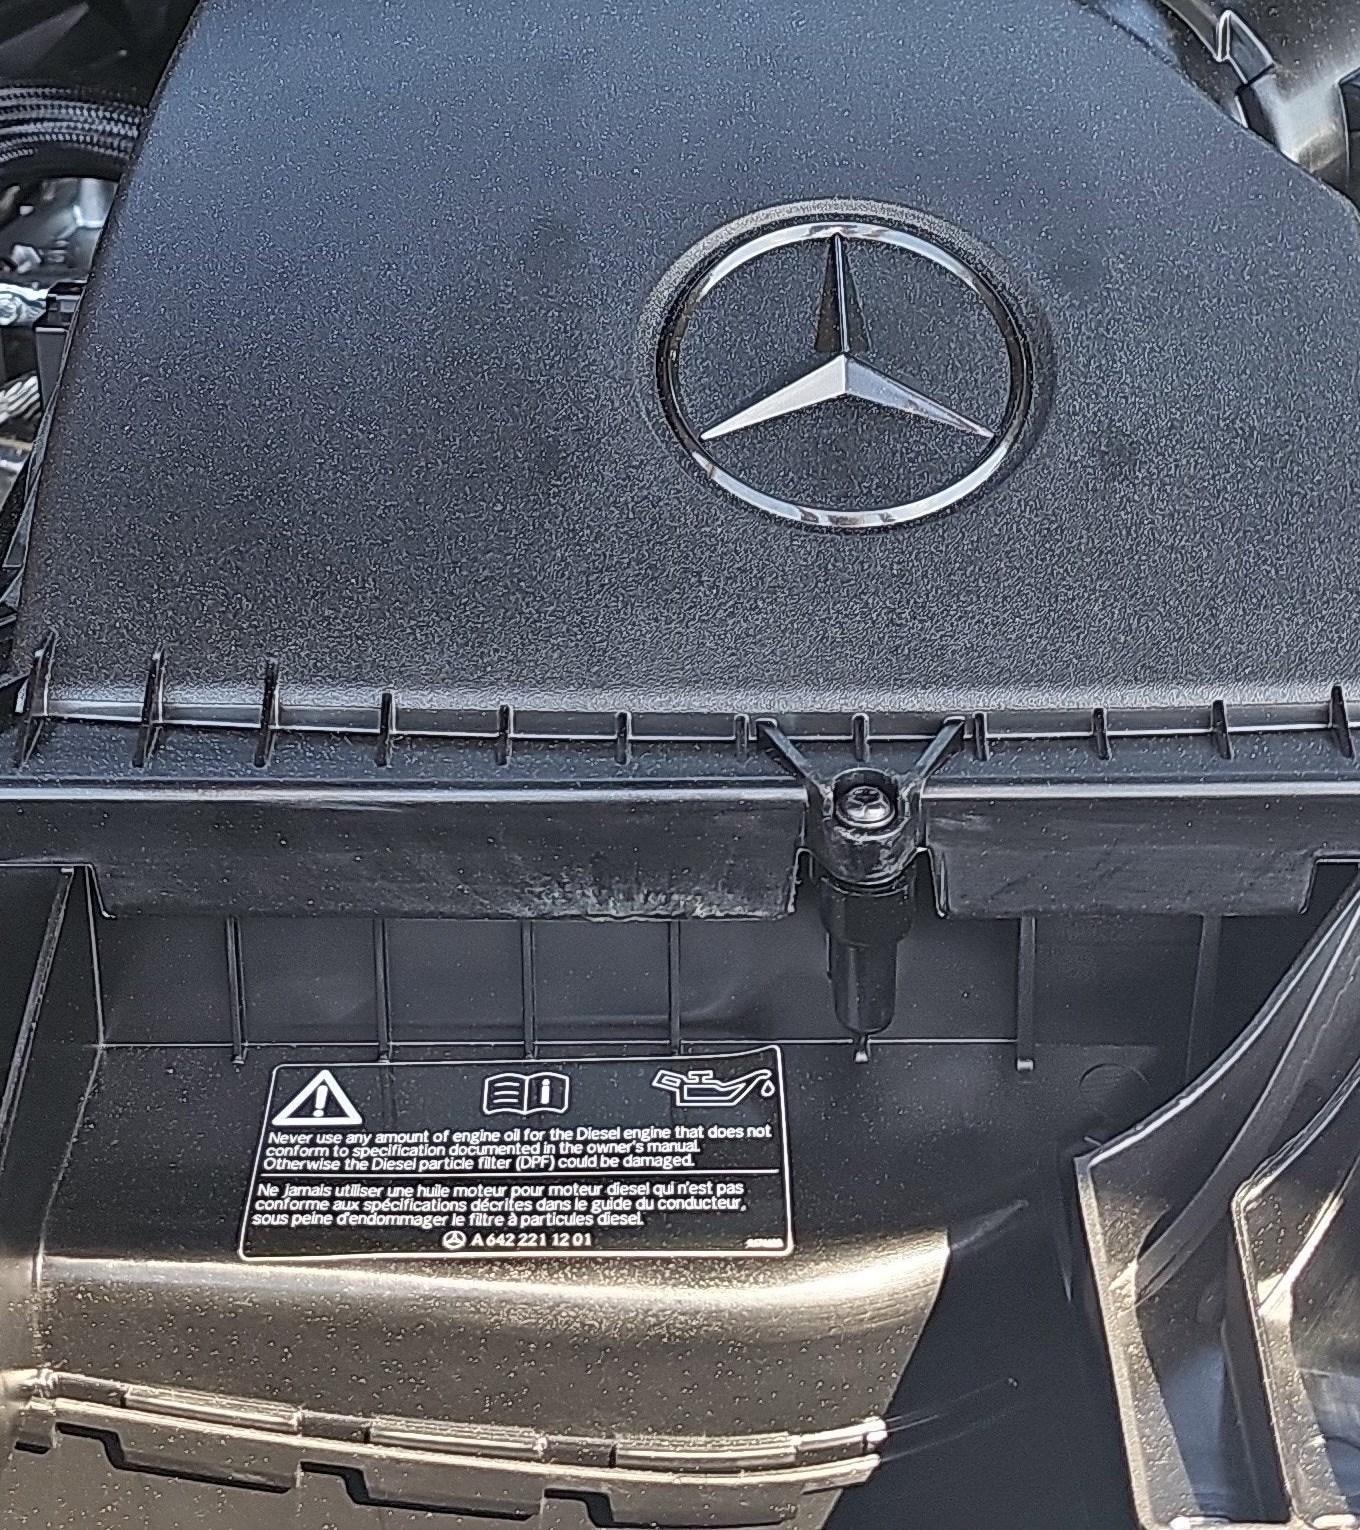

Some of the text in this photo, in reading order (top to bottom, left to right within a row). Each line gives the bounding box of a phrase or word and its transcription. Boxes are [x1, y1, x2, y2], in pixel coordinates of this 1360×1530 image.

[268, 1124, 773, 1146] Never use any amount of engine oil for the Diesel engine that does not
[266, 1139, 701, 1158] conform to specification documented in the owner's manual.
[263, 1153, 695, 1172] Otherwise the Diesel particle filter (DPF) could be damaged.
[257, 1181, 744, 1201] Ne jamais utiliser une huile moteur pour moteur diesel qui n'est pas
[255, 1197, 747, 1214] conforme aux spécifications décrites dans le guide du conducteur,
[252, 1212, 645, 1229] sous peine d'endommager le filtre à particules diesel.
[469, 1232, 592, 1247] A 642 221 12 01
